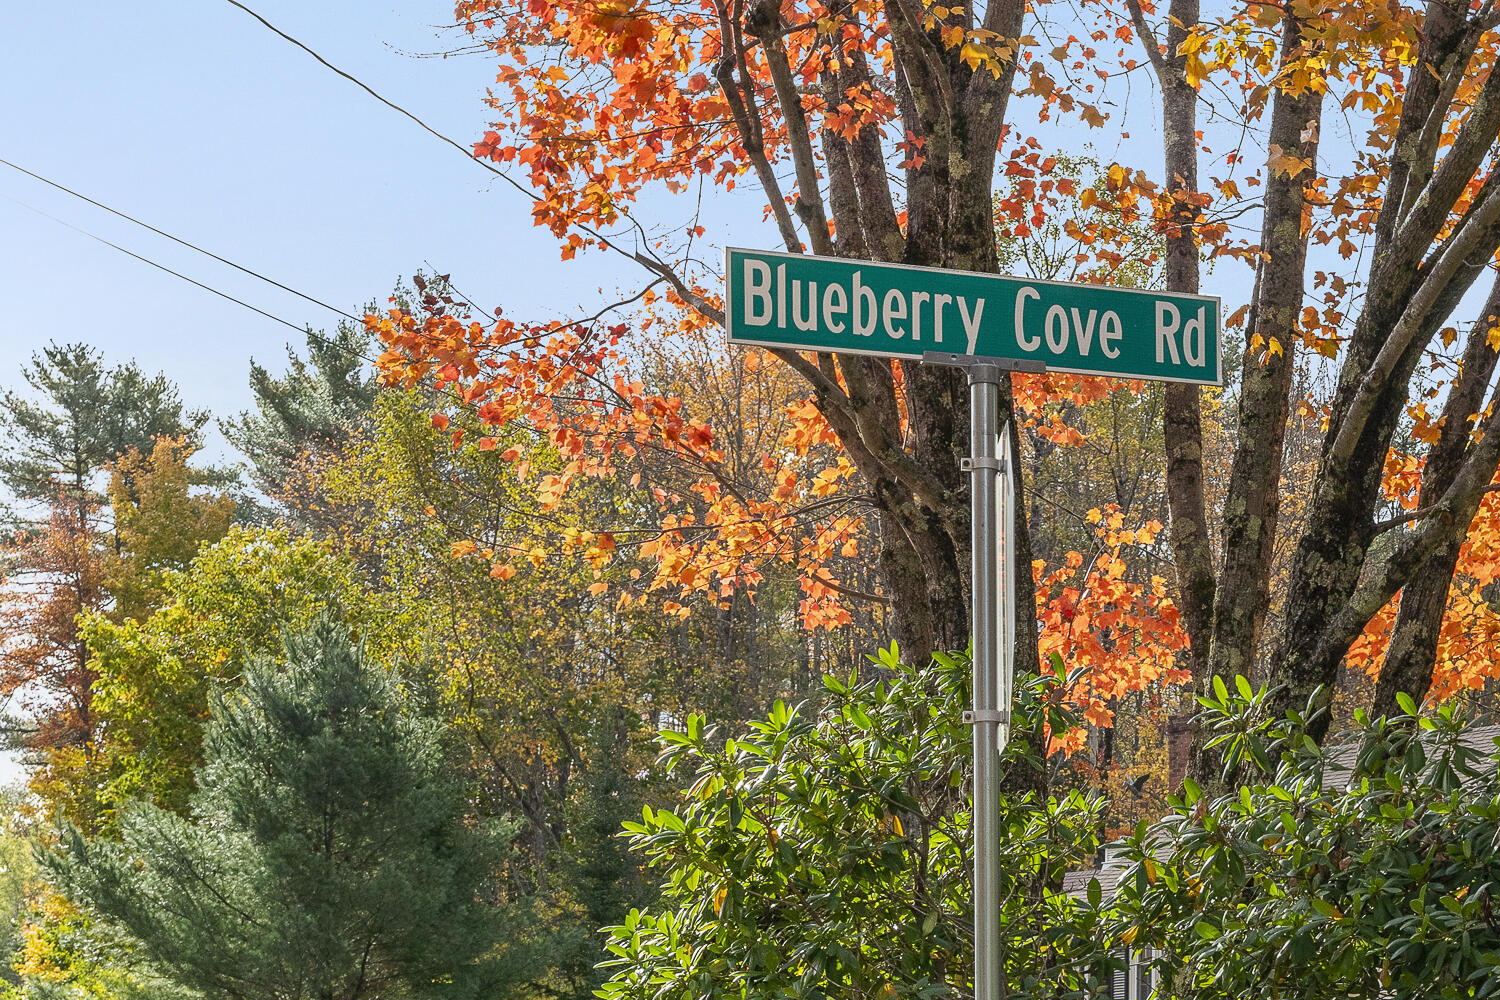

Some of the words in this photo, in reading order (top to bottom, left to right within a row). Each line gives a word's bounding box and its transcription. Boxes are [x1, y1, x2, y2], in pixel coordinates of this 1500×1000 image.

[743, 258, 985, 355] Blueberry
[1014, 286, 1123, 359] Cove
[1155, 301, 1206, 368] Rd
